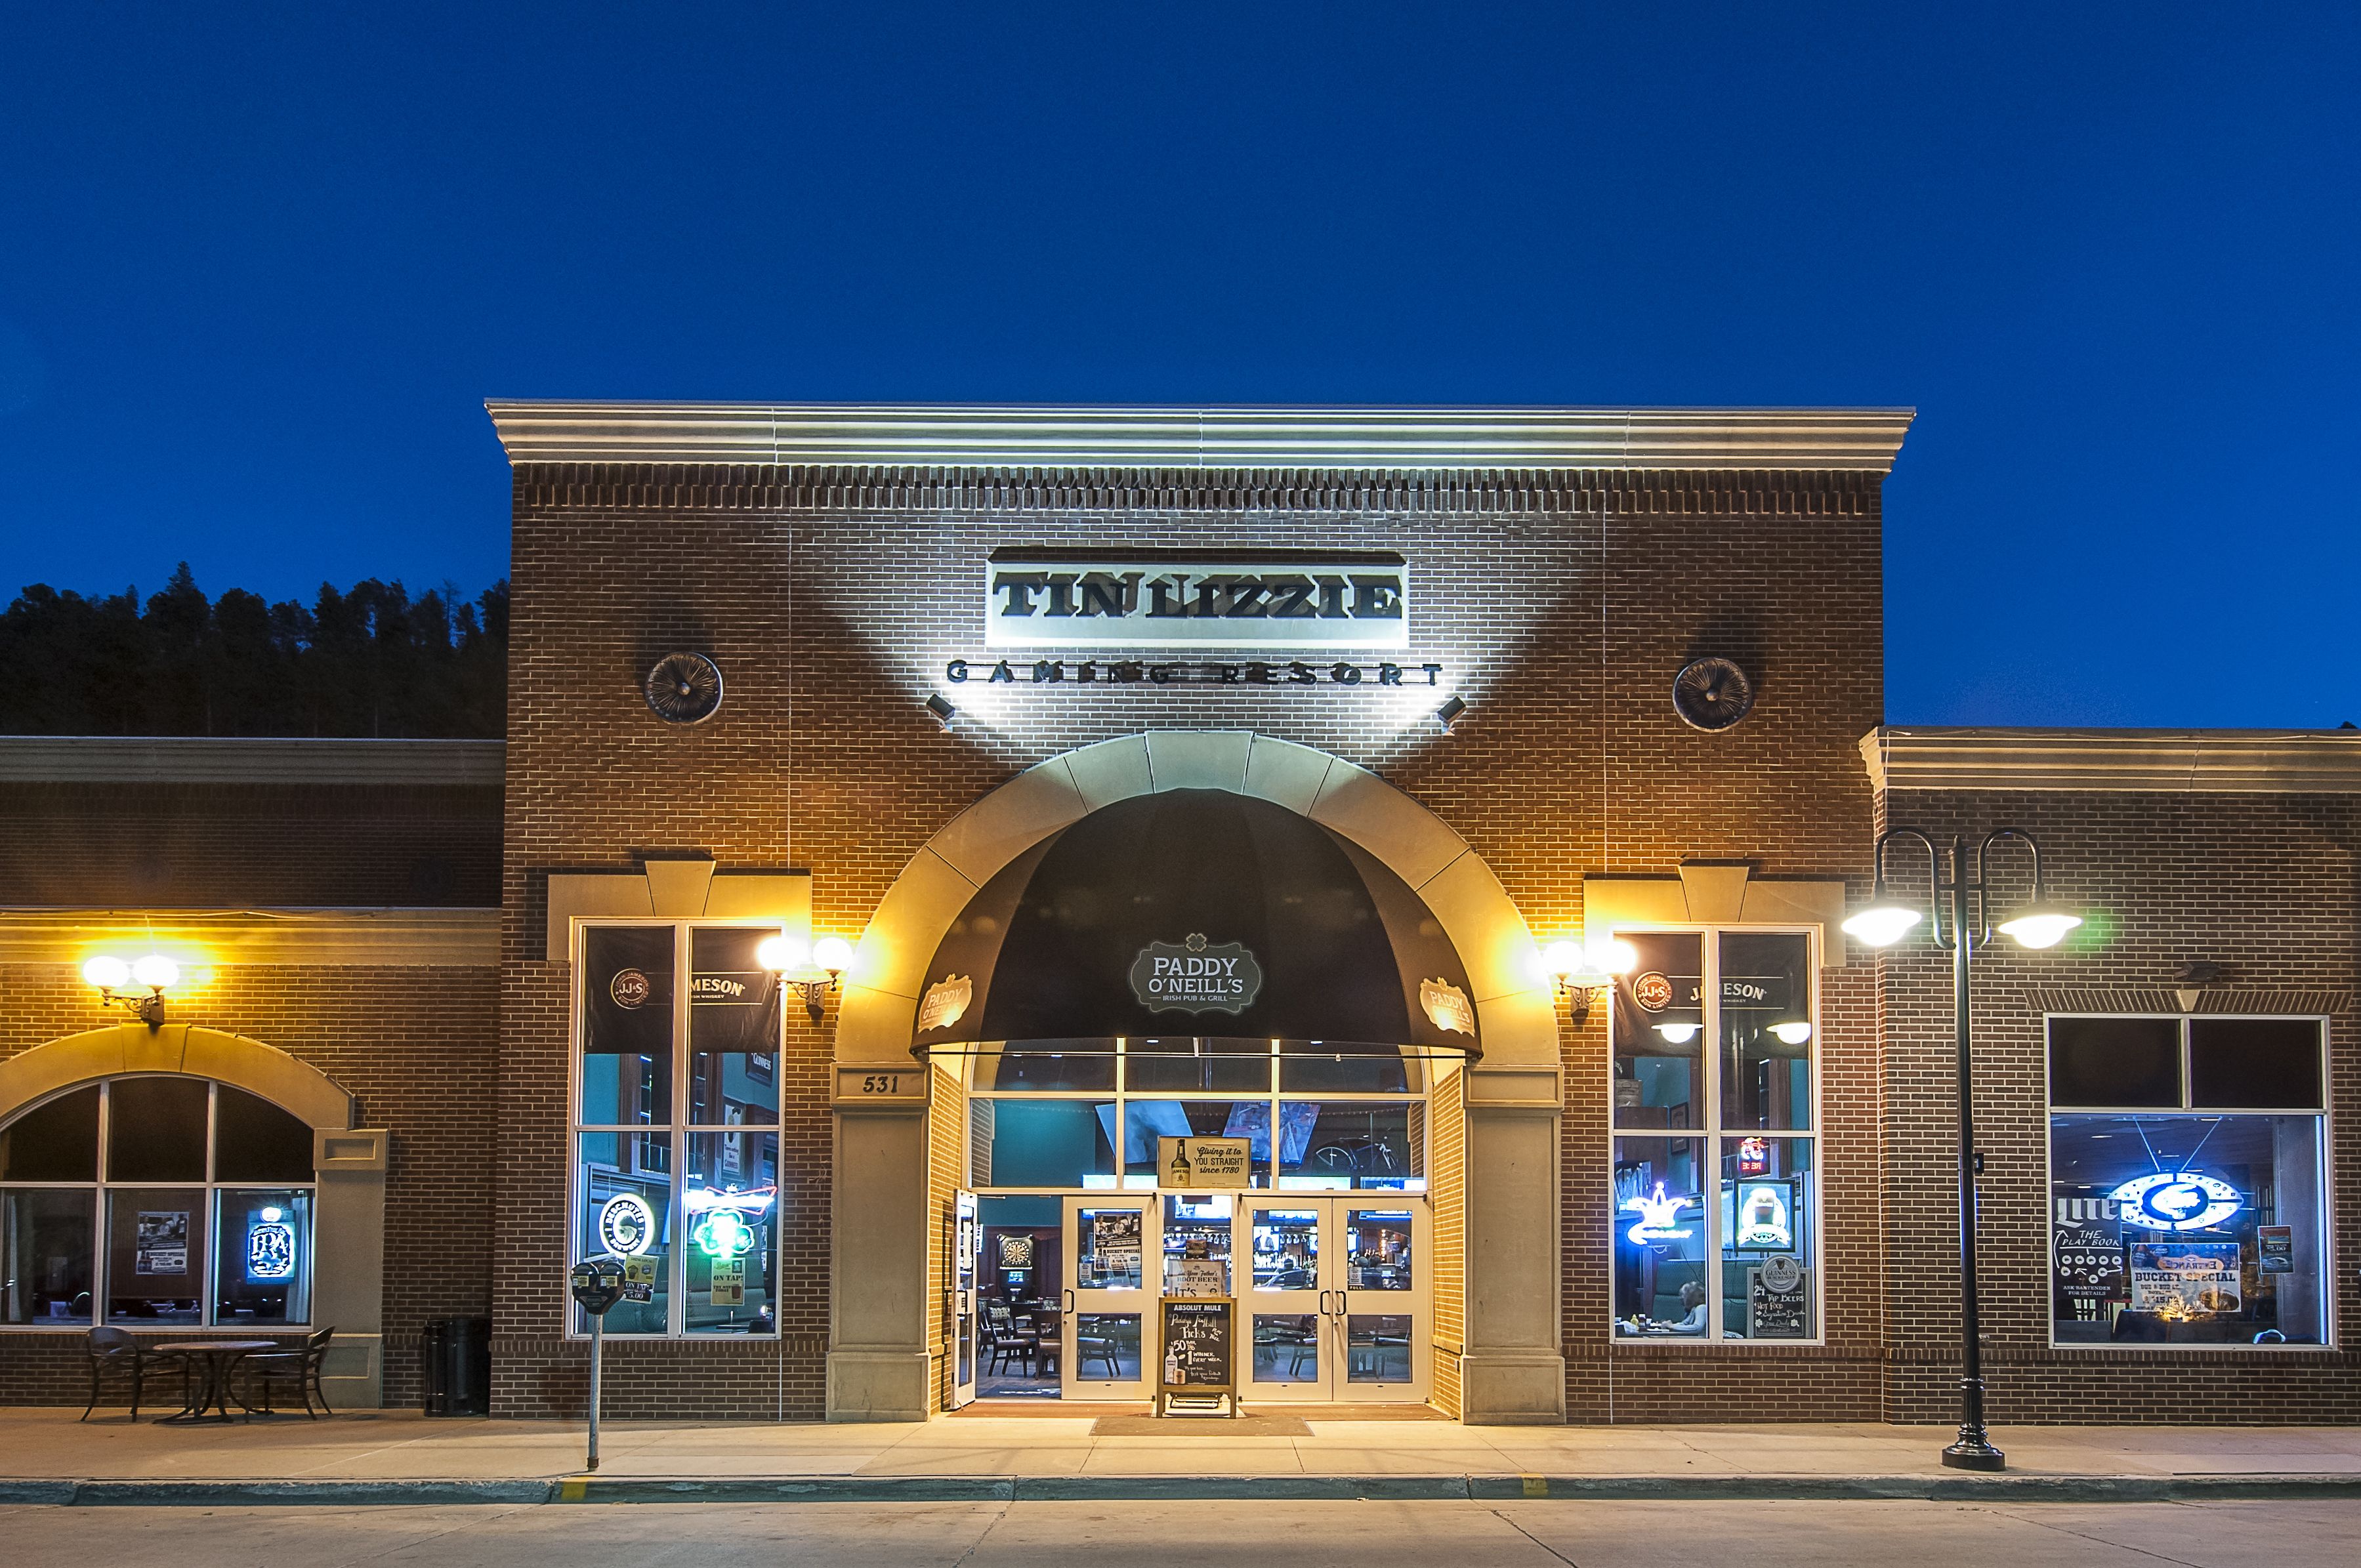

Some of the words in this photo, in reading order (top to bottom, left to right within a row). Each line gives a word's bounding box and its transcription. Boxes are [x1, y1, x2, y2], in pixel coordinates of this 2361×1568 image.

[993, 573, 1140, 619] TIN
[1144, 575, 1403, 619] LIZZIE
[946, 659, 1171, 686] GAMING
[1220, 660, 1444, 686] RESORT
[1154, 957, 1238, 976] PADDY
[1148, 978, 1243, 993] O'NEILL'S
[1637, 978, 1648, 991] JOHN
[1650, 976, 1671, 991] JAMESON
[927, 988, 963, 1008] PADDY
[1641, 986, 1665, 997] JJ&S
[1429, 991, 1464, 1011] PADDY
[1640, 999, 1652, 1008] SON
[1652, 995, 1671, 1008] LIMITED
[862, 1075, 898, 1094] 531
[1197, 1146, 1224, 1157] Giving
[1211, 1157, 1244, 1166] STRAIGHT
[605, 1202, 644, 1224] DESCHUTES
[2079, 1230, 2102, 1239] THE
[2135, 1272, 2182, 1282] BUCKET
[2186, 1272, 2236, 1282] SPECIAL
[1753, 1285, 1766, 1296] 24
[1187, 1351, 1193, 1365] 1
